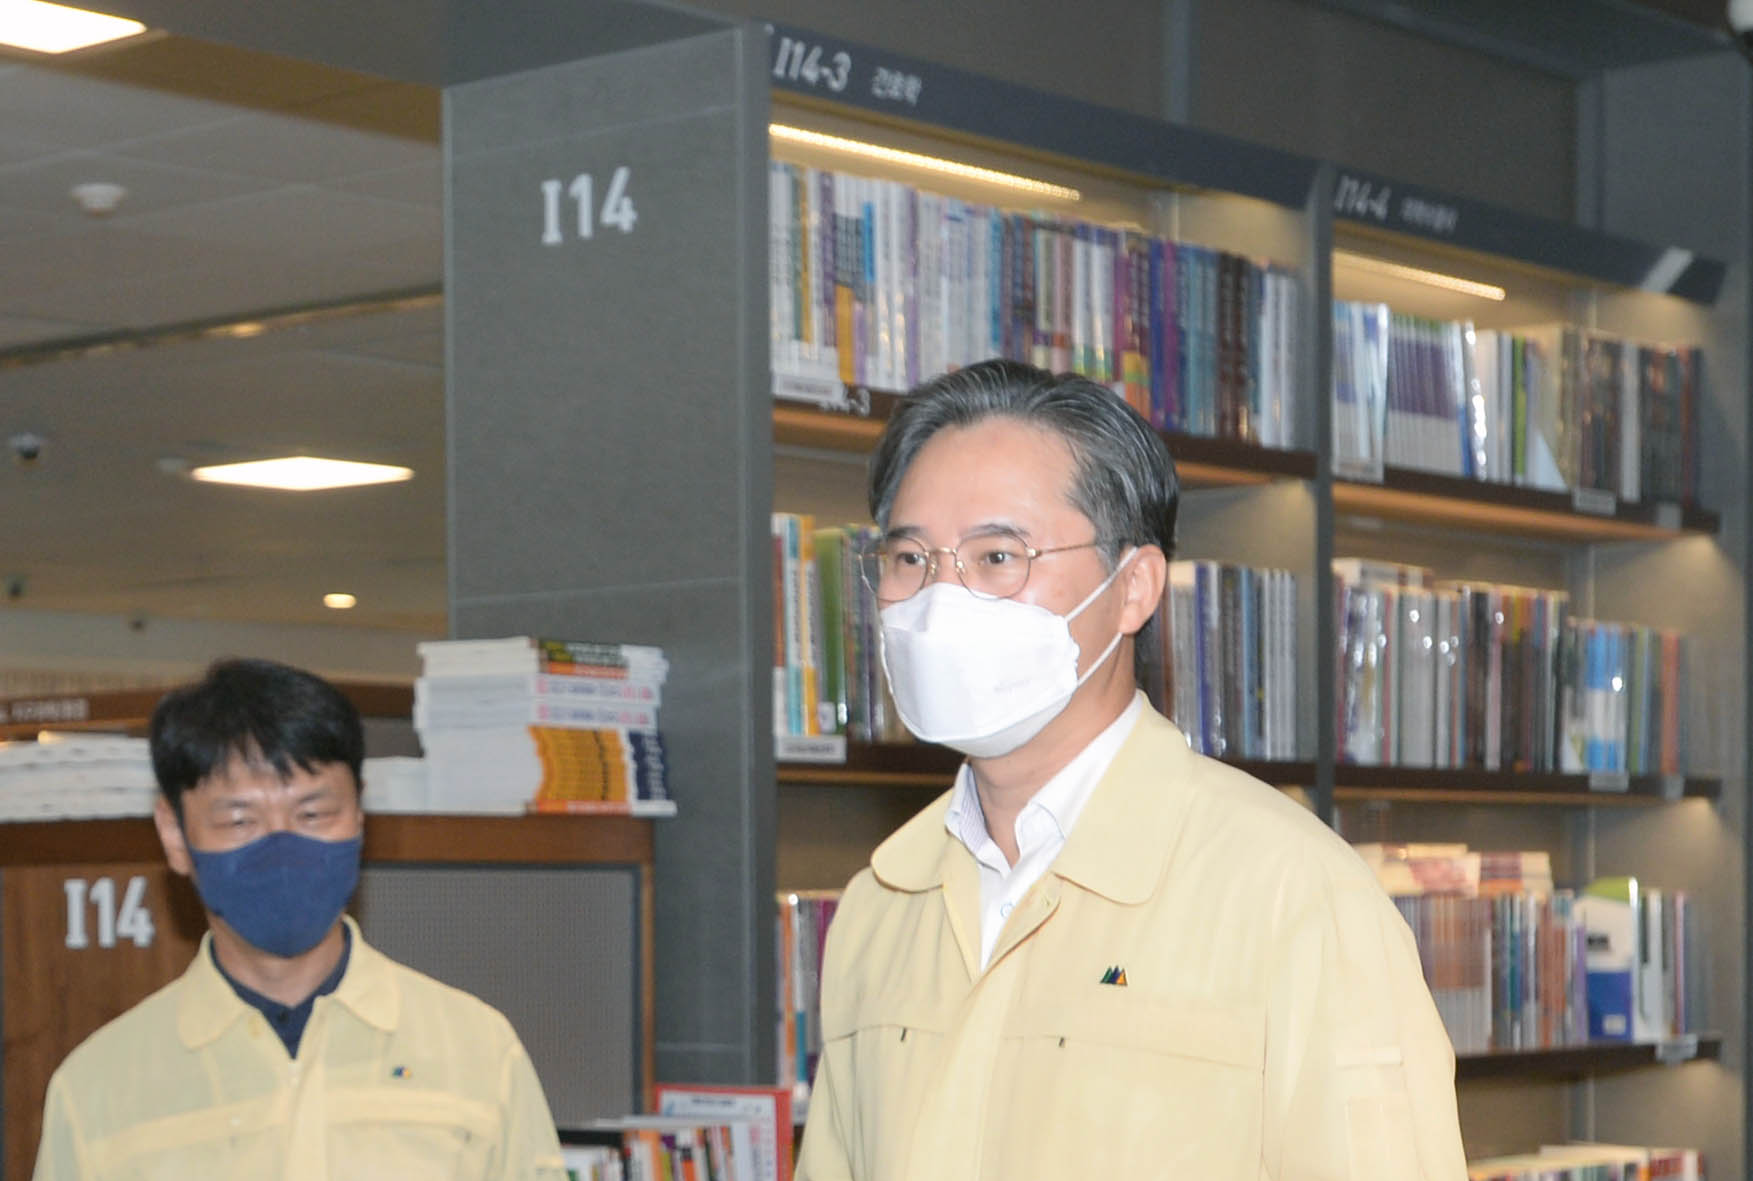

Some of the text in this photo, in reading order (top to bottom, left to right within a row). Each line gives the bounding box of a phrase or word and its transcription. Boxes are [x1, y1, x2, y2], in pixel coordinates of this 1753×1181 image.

[773, 36, 852, 92] I14-3
[540, 166, 638, 246] I14
[63, 876, 156, 950] I14
